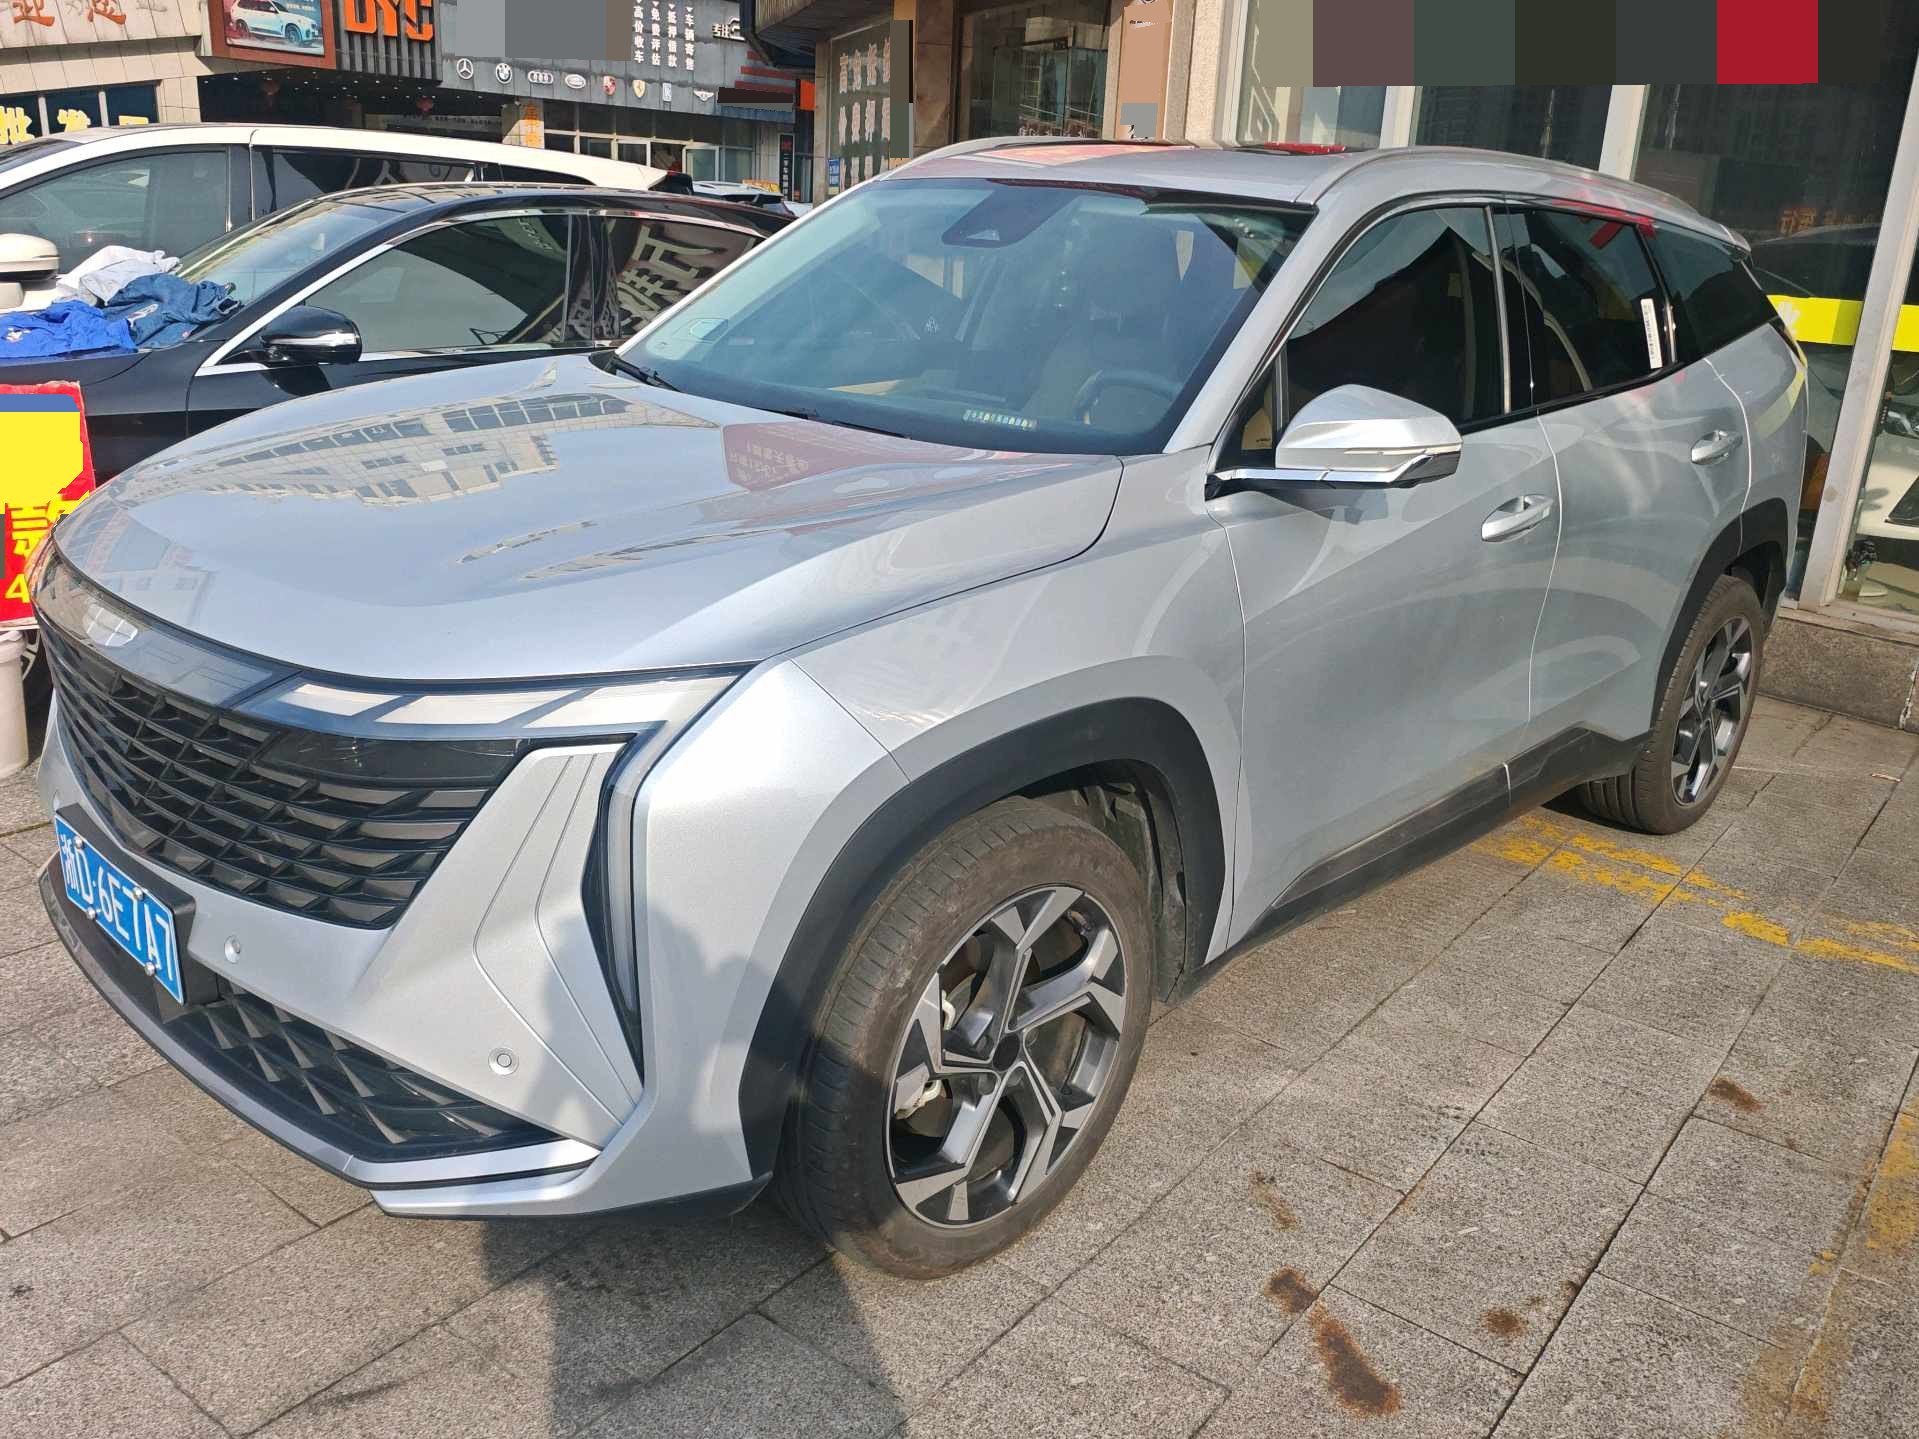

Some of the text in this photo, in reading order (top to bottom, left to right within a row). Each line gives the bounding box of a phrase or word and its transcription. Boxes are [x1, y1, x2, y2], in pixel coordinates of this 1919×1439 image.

[633, 6, 645, 64] 高价收车
[650, 8, 661, 66] 免费评估
[684, 14, 695, 71] 车辆寄售
